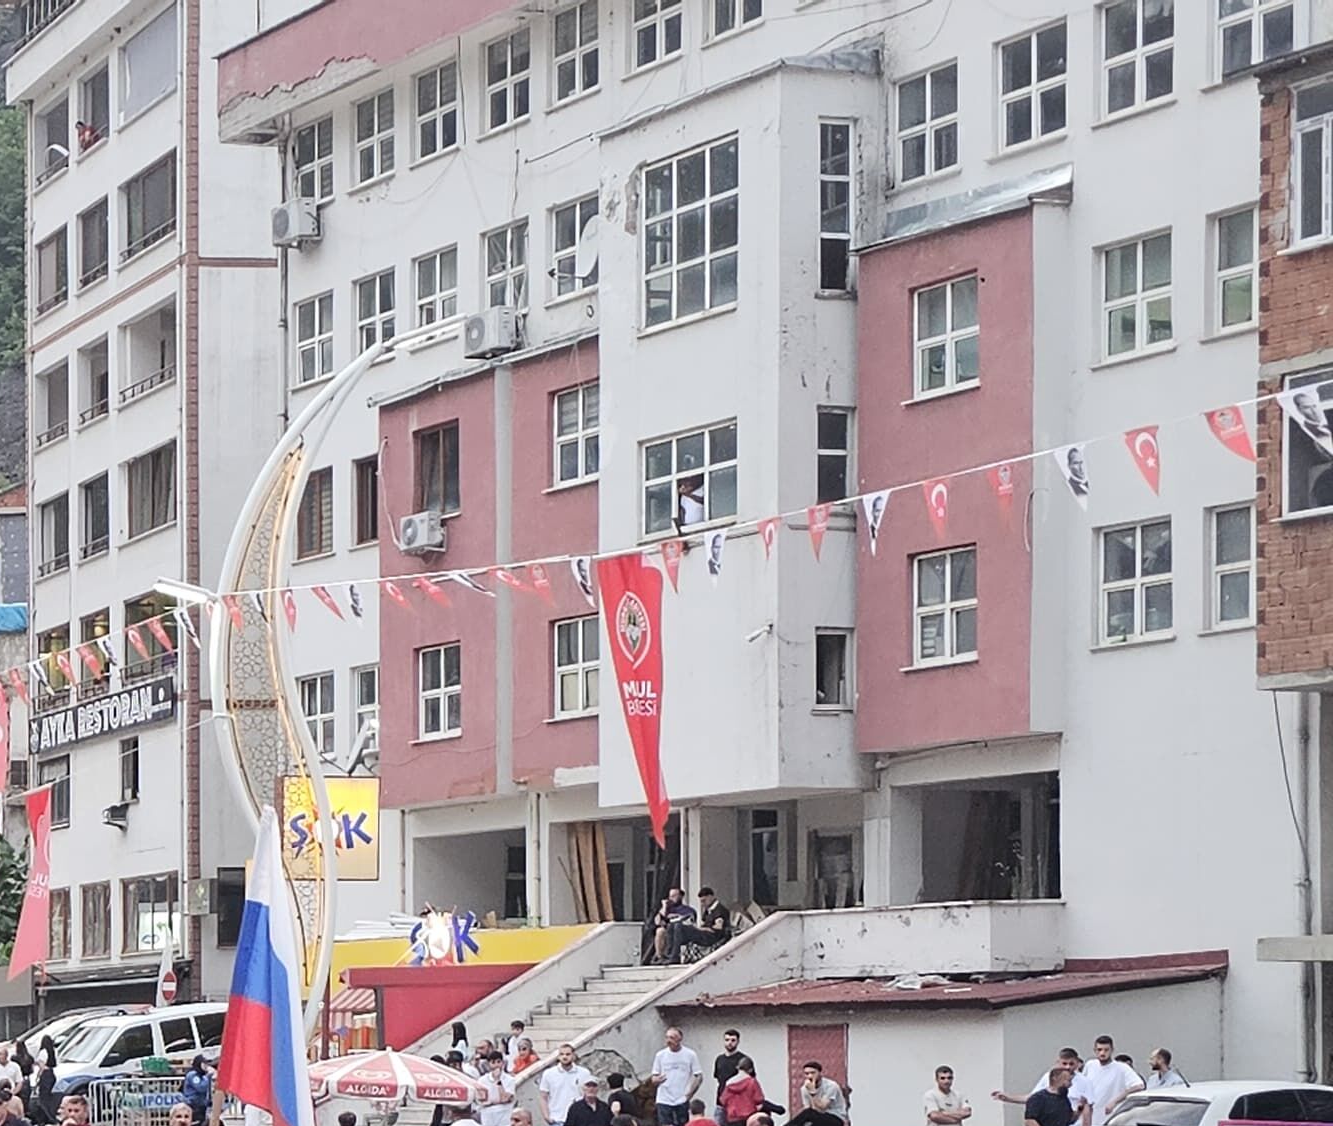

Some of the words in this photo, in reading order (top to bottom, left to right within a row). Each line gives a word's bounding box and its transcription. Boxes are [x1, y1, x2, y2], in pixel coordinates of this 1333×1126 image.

[77, 686, 153, 739] RESTORAN
[345, 1084, 386, 1096] ALGIDA
[423, 1088, 459, 1098] ALGIDA
